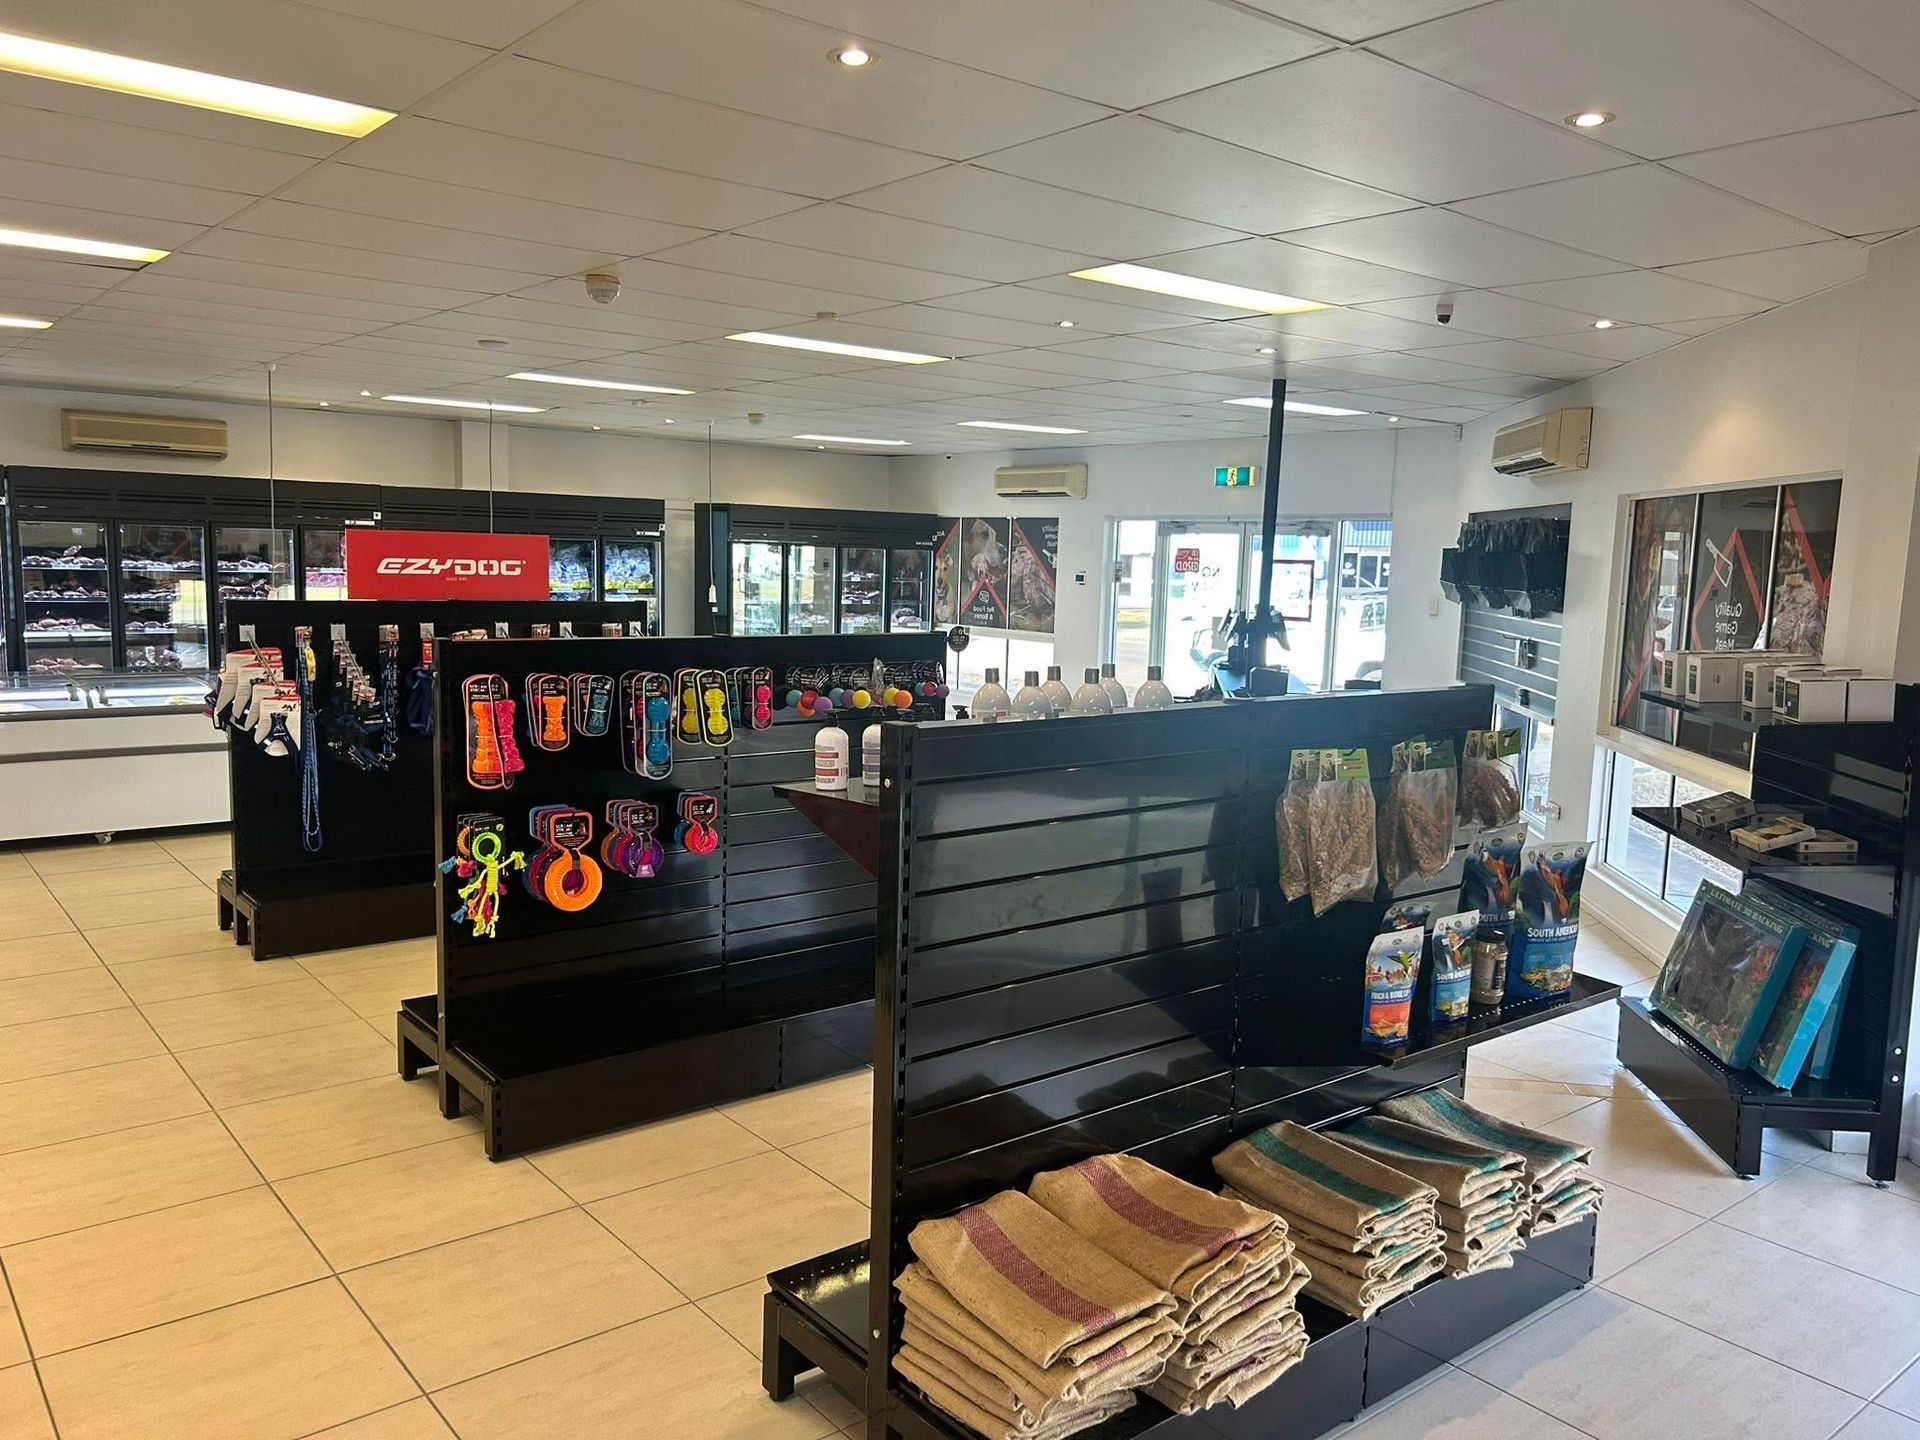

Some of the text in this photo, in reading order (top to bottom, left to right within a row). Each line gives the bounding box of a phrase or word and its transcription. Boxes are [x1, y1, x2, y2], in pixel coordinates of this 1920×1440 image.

[376, 557, 522, 576] EZYDOG
[1176, 561, 1199, 571] CLOSED
[1710, 888, 1742, 911] ULTIMATE
[1752, 910, 1783, 934] BACKING
[1479, 913, 1499, 922] OUTH
[1527, 927, 1554, 938] SOUTH
